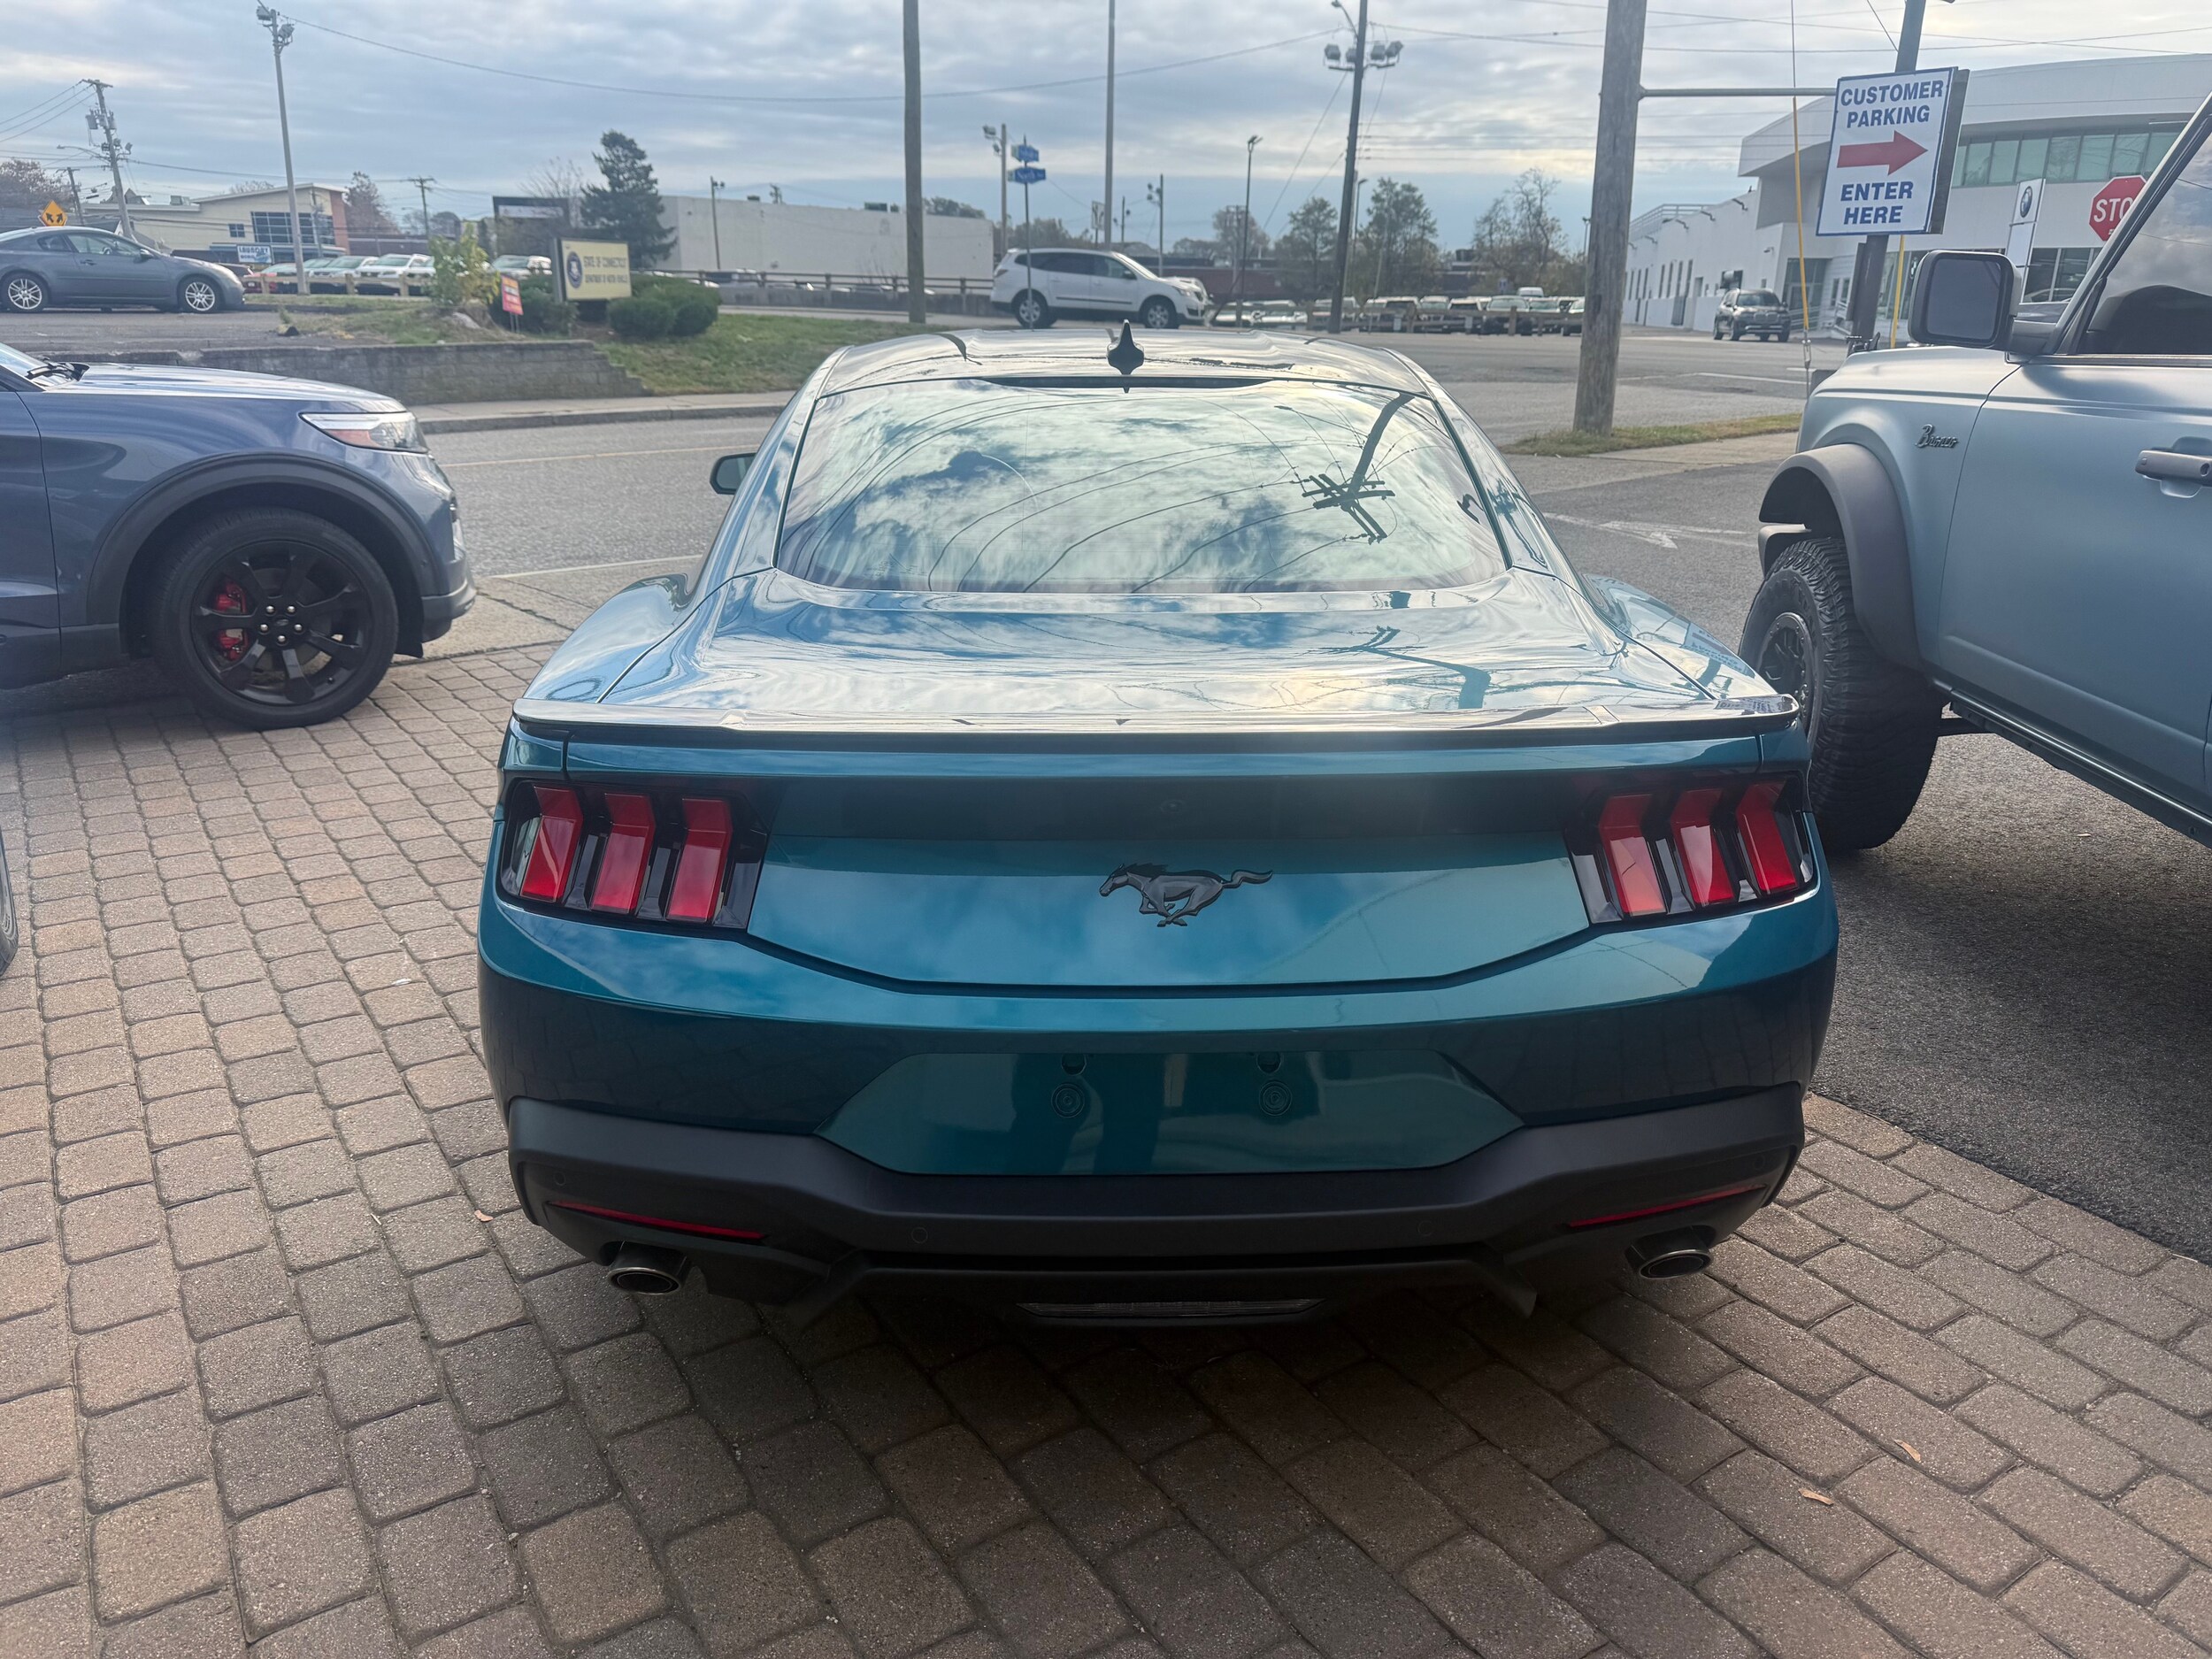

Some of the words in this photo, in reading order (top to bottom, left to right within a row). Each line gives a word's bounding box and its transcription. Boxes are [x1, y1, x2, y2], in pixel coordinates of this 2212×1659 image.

[1840, 80, 1944, 106] CUSTOMER
[1847, 104, 1930, 128] PARKING
[1840, 181, 1914, 202] ENTER
[1843, 205, 1903, 225] HERE
[2093, 196, 2133, 222] STO
[1915, 424, 1958, 449] Bronco
